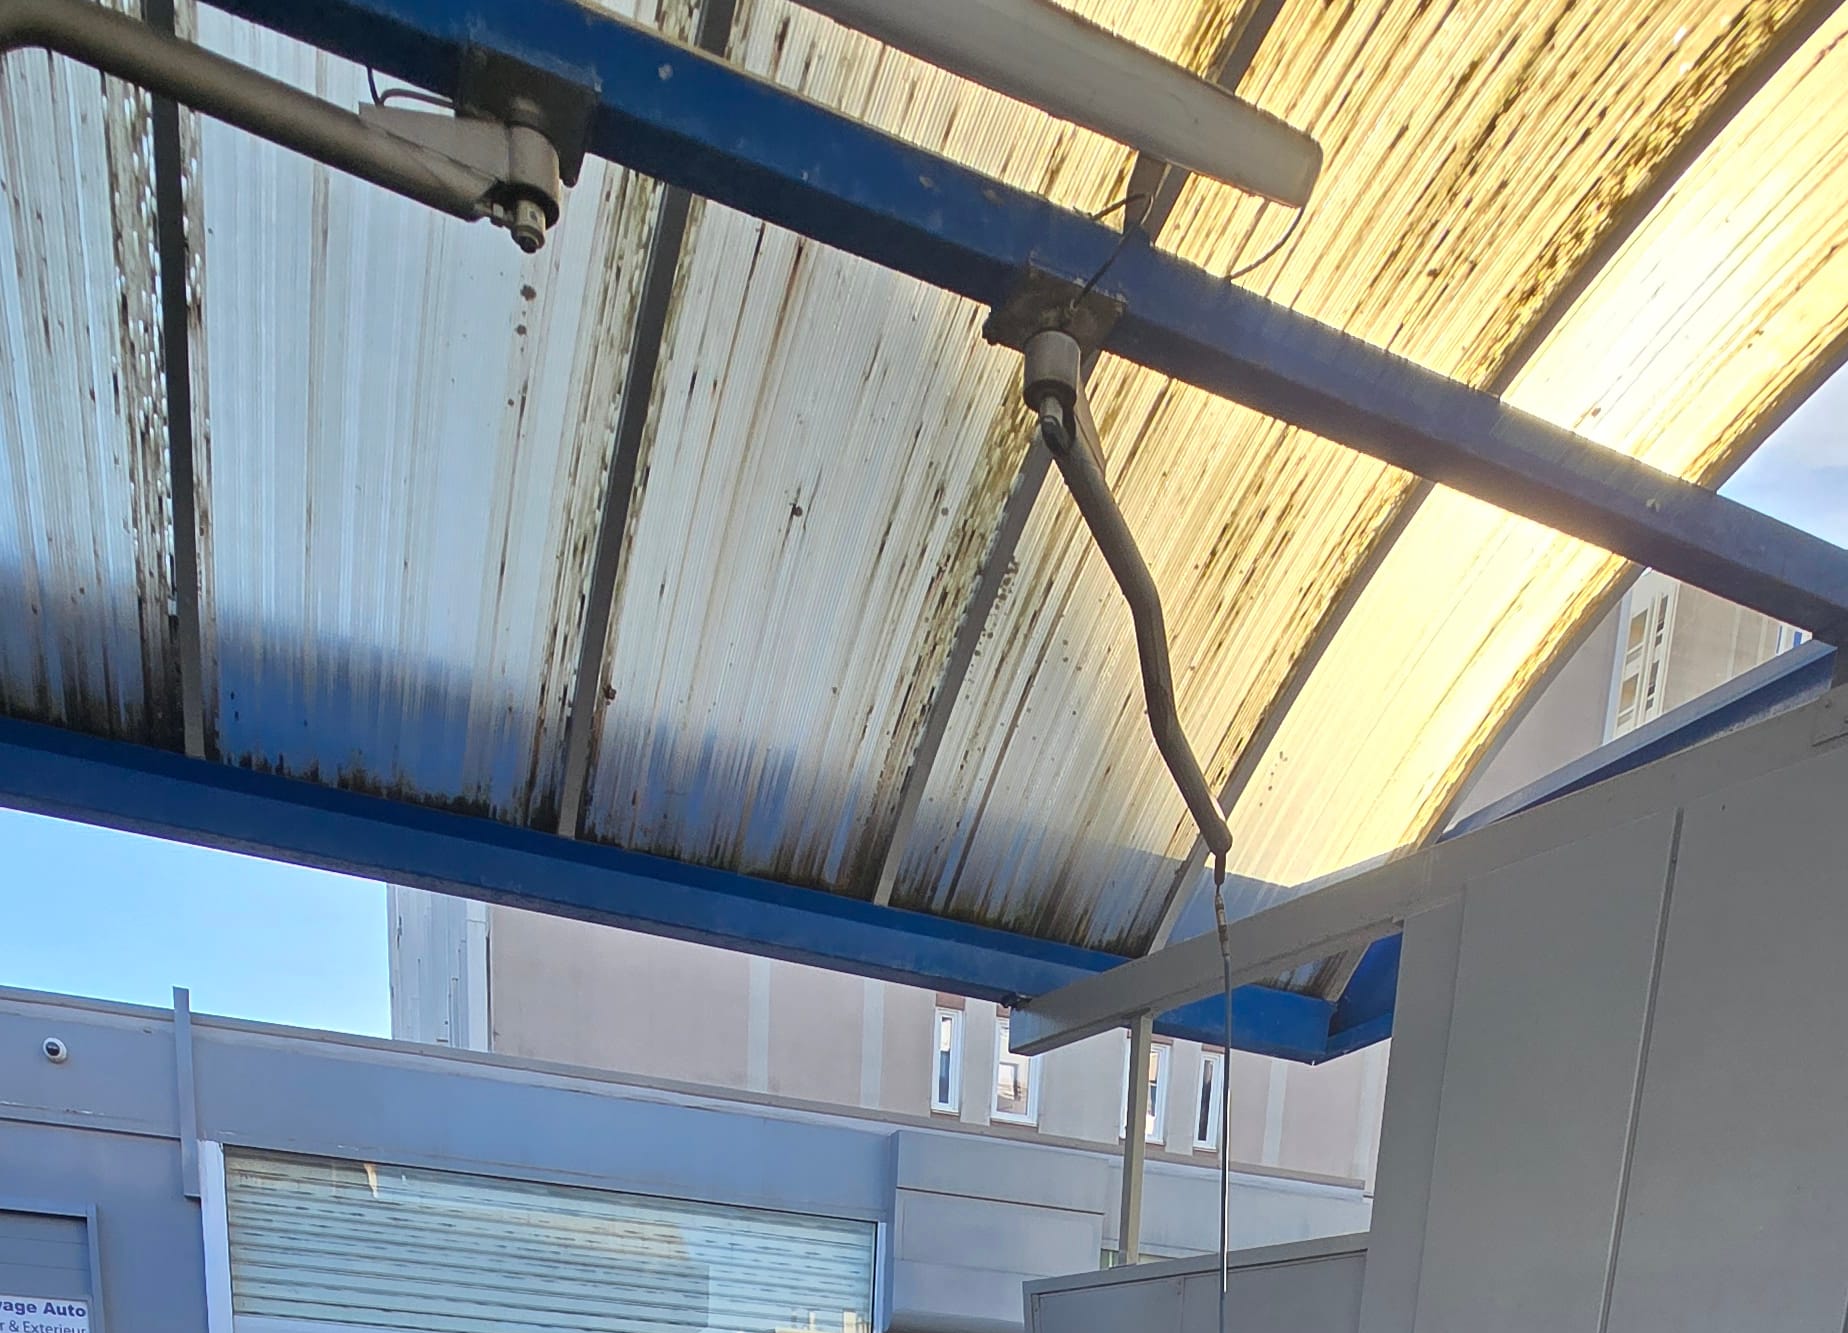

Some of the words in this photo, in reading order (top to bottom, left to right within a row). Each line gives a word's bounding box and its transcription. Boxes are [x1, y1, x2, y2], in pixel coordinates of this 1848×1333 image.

[0, 1301, 37, 1316] age
[43, 1302, 87, 1318] Auto
[9, 1320, 19, 1333] &
